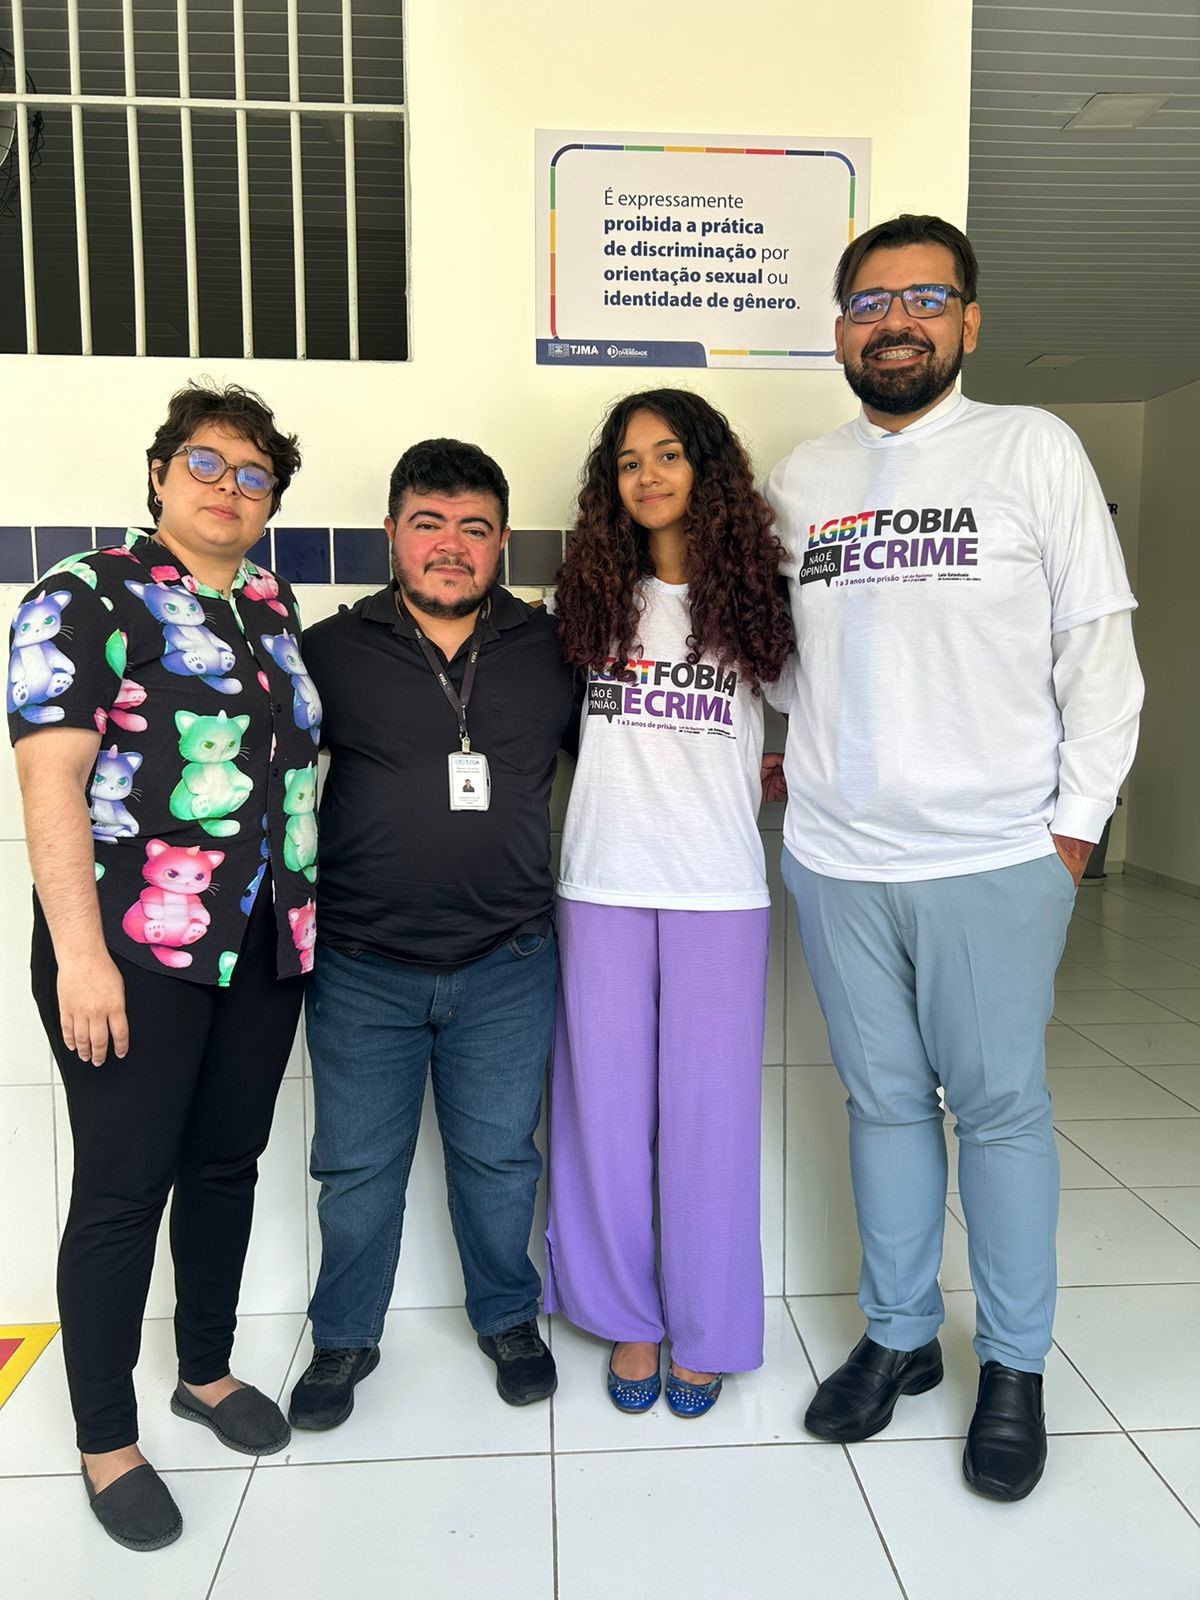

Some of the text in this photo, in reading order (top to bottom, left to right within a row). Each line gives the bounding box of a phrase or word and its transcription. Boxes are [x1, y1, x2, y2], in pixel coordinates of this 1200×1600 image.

[604, 187, 744, 210] É expressamente
[604, 216, 764, 236] proibida a prática
[604, 241, 789, 263] de discriminação por
[604, 266, 789, 286] orientação sexual ou
[604, 290, 801, 312] identidade de gênero.
[570, 345, 599, 355] TJMA
[807, 507, 978, 549] LGBTFOBIA
[809, 549, 832, 565] NÃO É
[842, 538, 979, 573] É CRIME
[800, 561, 838, 578] OPINIÃO.
[876, 575, 900, 584] prisão
[606, 687, 613, 699] É
[656, 722, 677, 730] prisão
